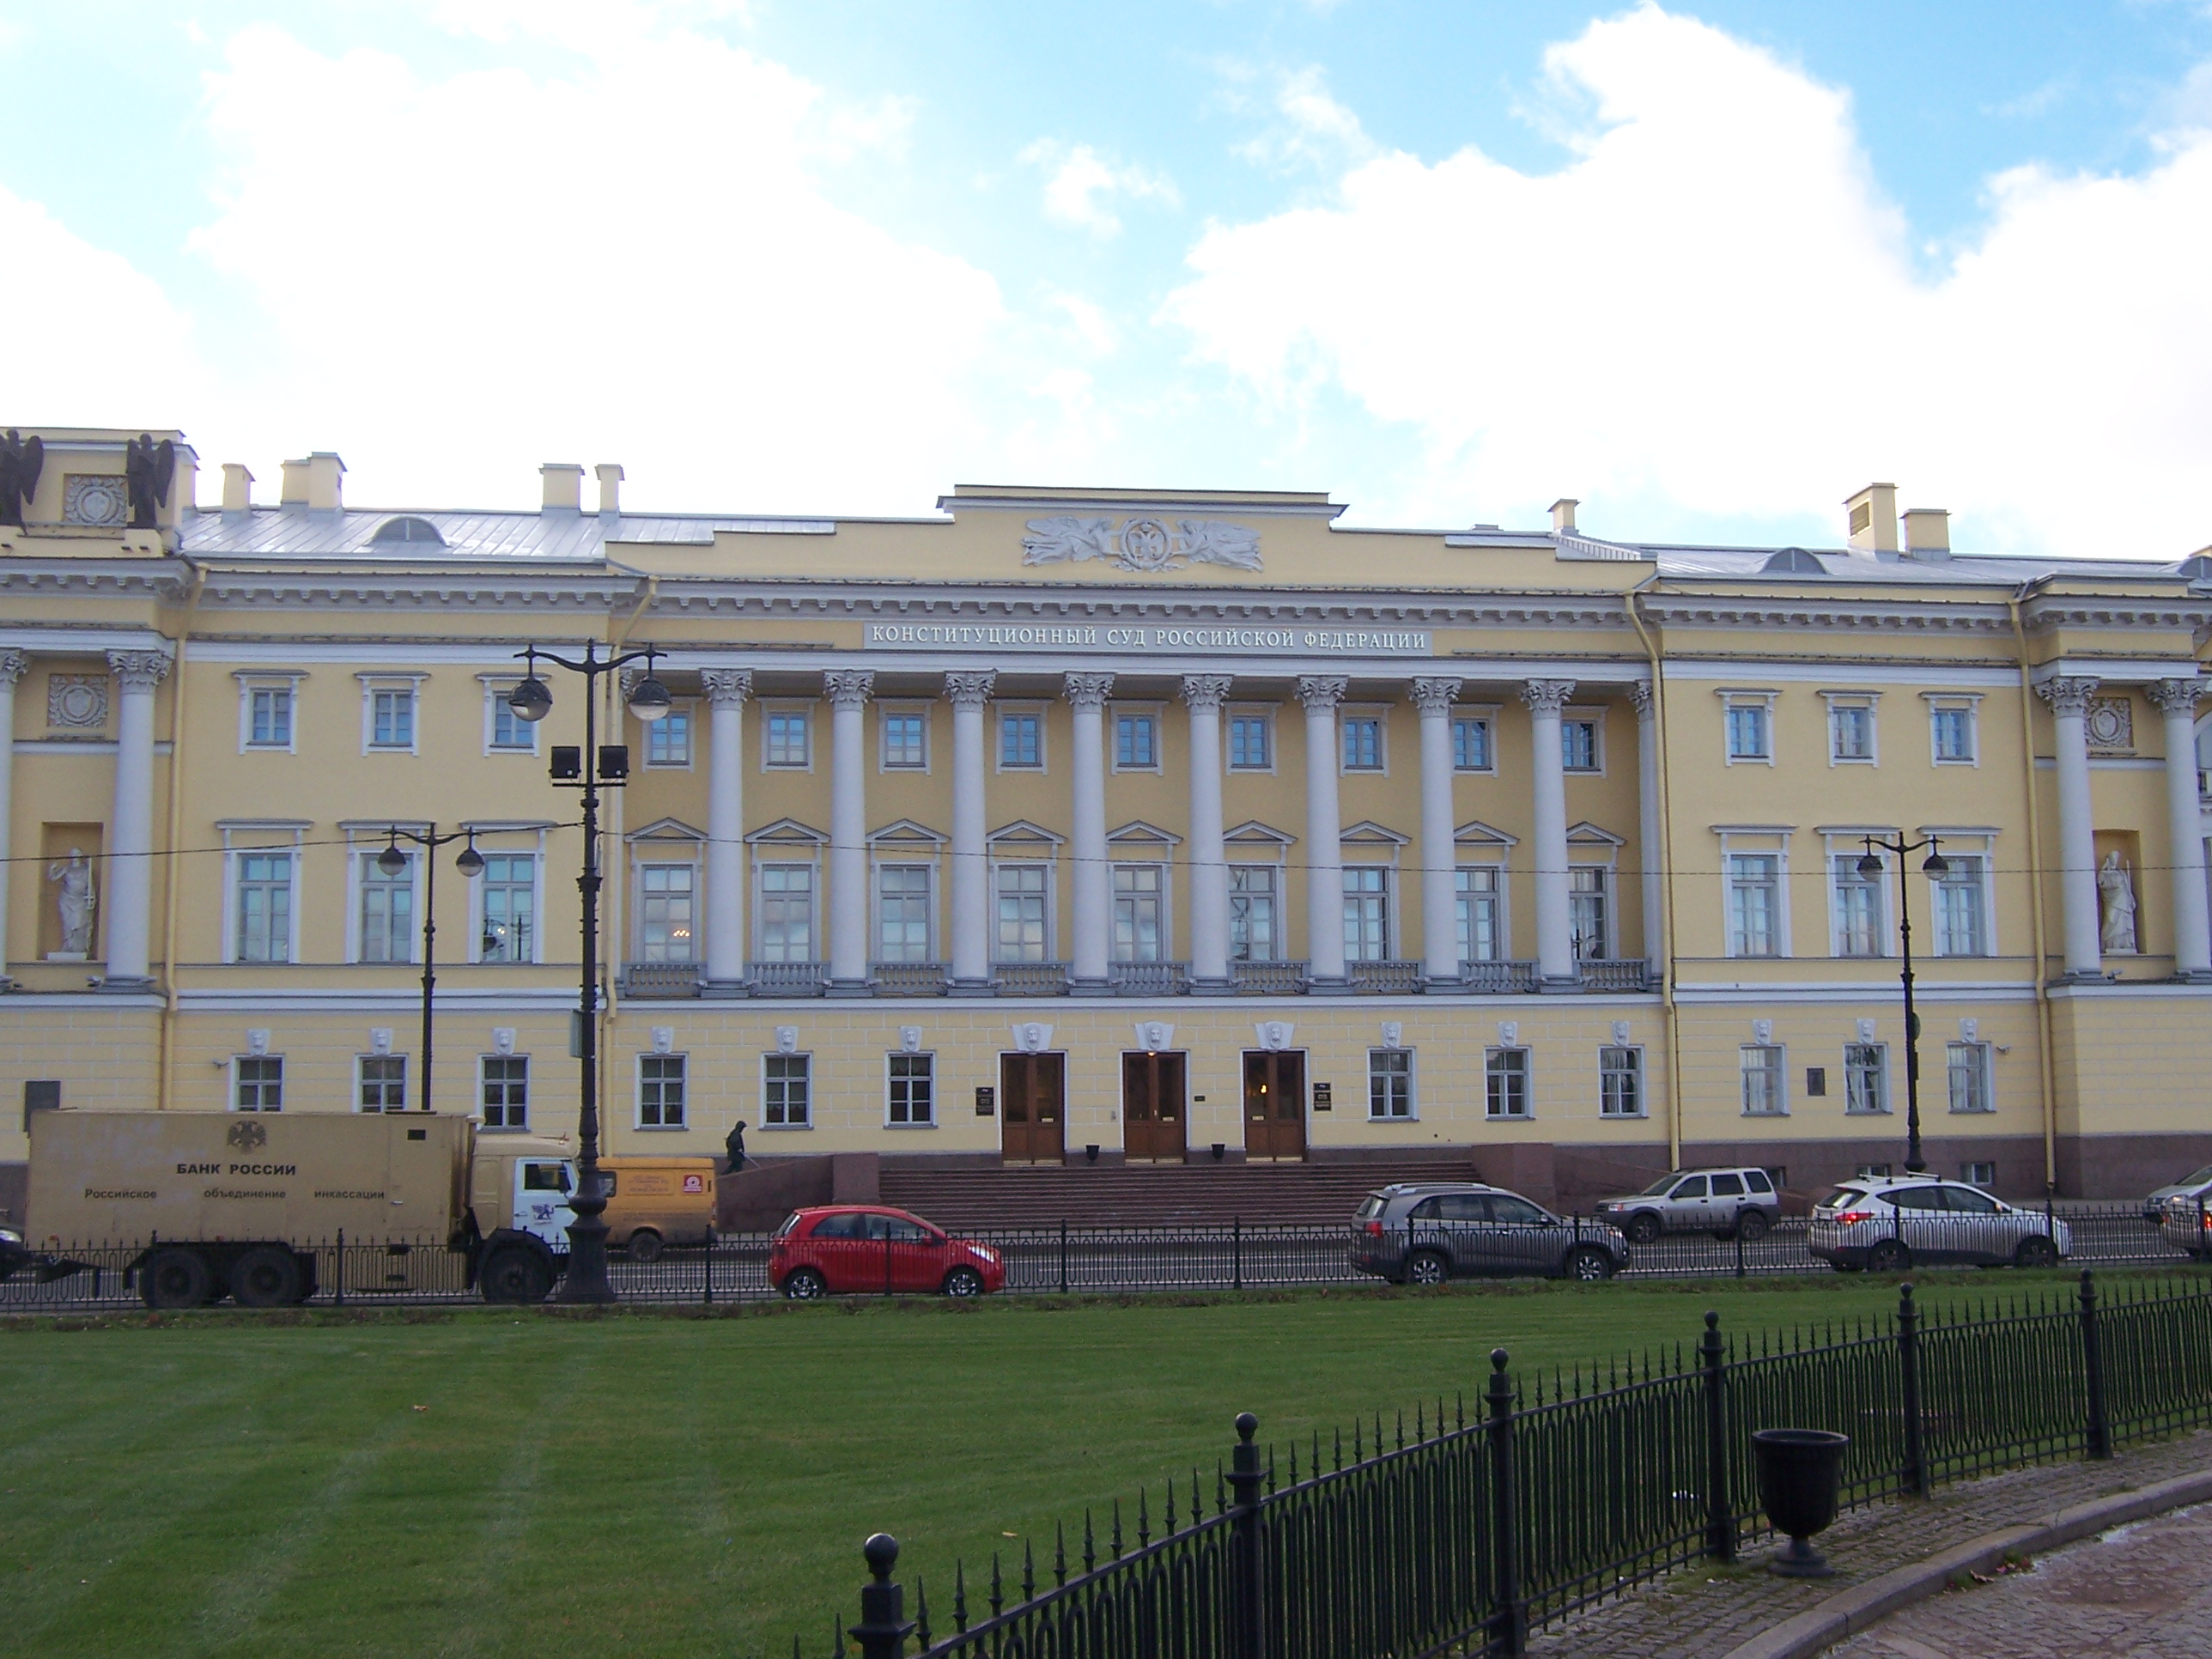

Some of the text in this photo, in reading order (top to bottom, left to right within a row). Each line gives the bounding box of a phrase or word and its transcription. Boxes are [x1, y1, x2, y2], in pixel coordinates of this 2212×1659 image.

[872, 625, 1425, 650] КОНСТИТУЦИОННЫЙ СУД РОССИЙСКОЙ ФЕДЕРАЦИИ
[176, 1164, 296, 1176] БАНК РОССИИ
[85, 1188, 385, 1200] Российское объединение инкассации
